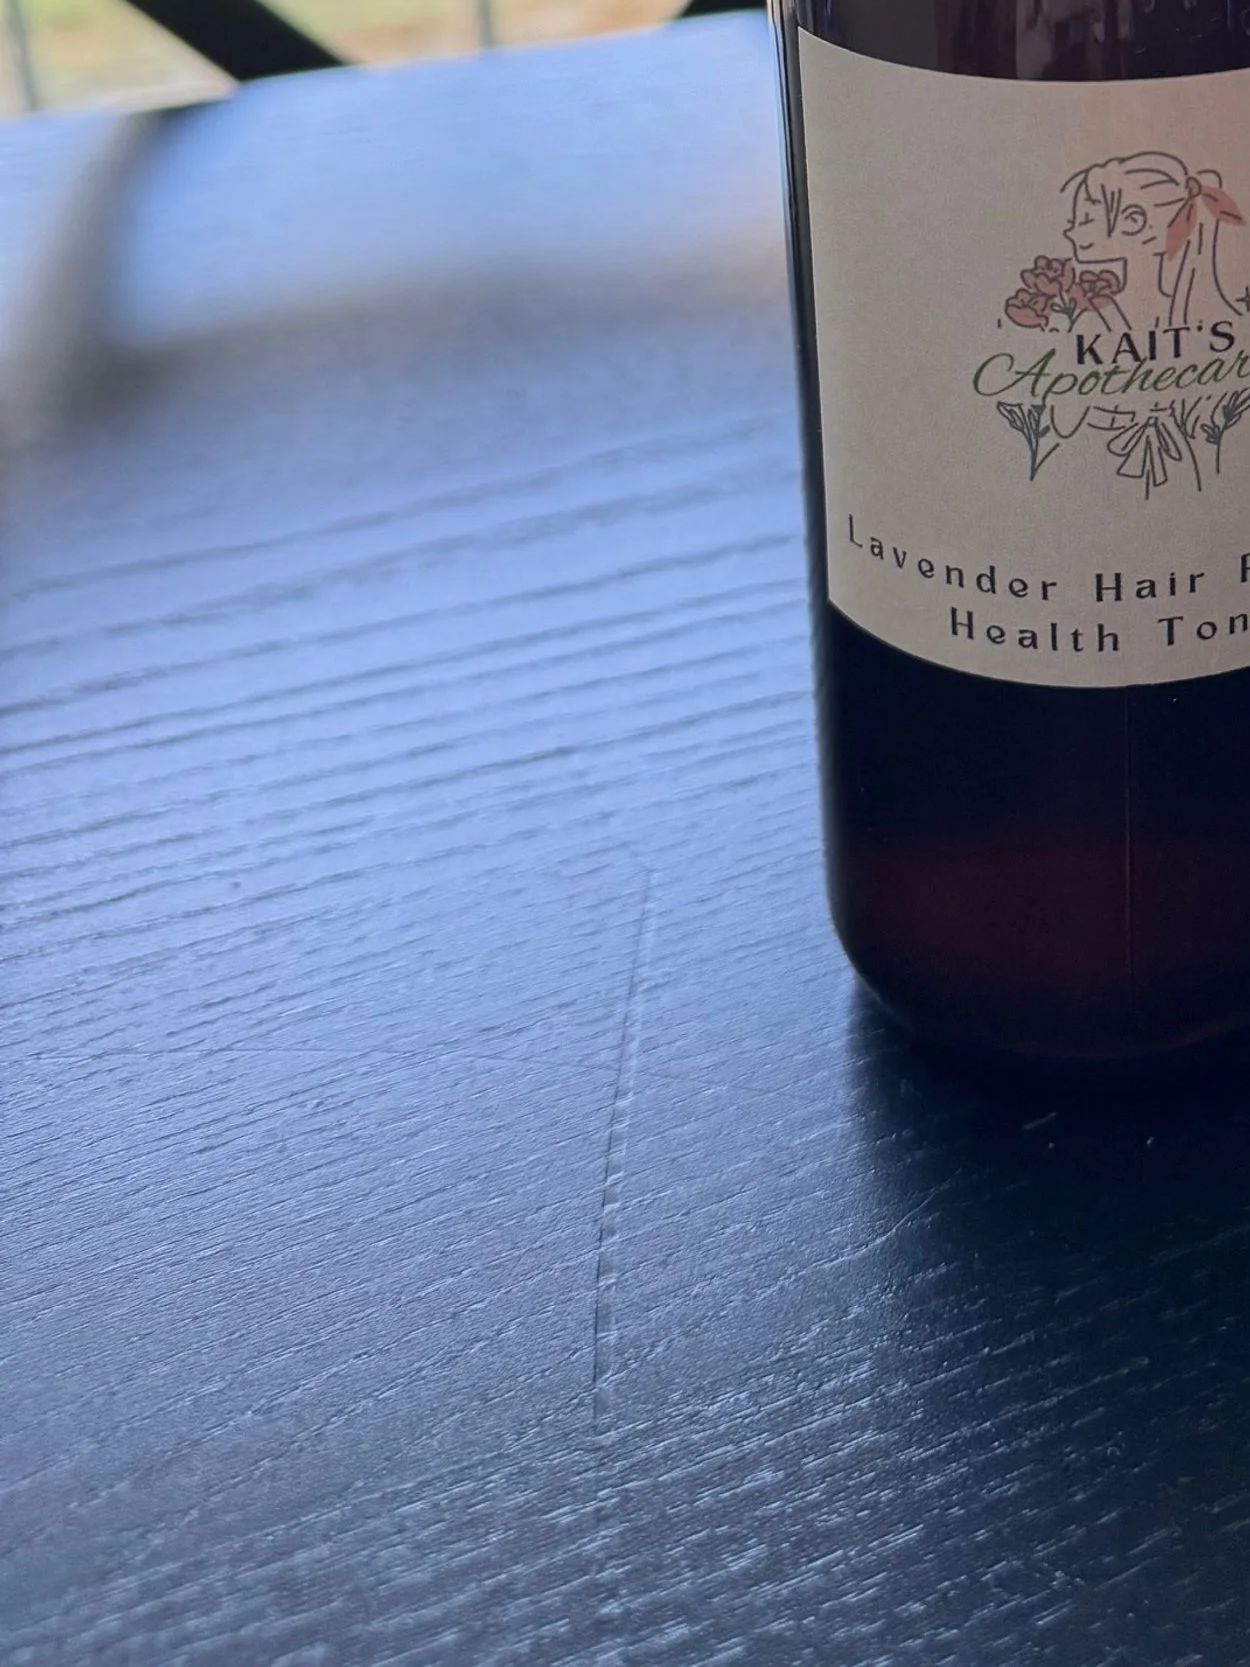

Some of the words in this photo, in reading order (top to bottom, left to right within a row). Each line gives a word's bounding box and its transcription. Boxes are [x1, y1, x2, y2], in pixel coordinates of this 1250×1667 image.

[1075, 319, 1236, 366] KAIT'S
[847, 514, 1058, 602] Lavender
[1095, 568, 1205, 603] Hair
[950, 607, 1121, 653] Health
